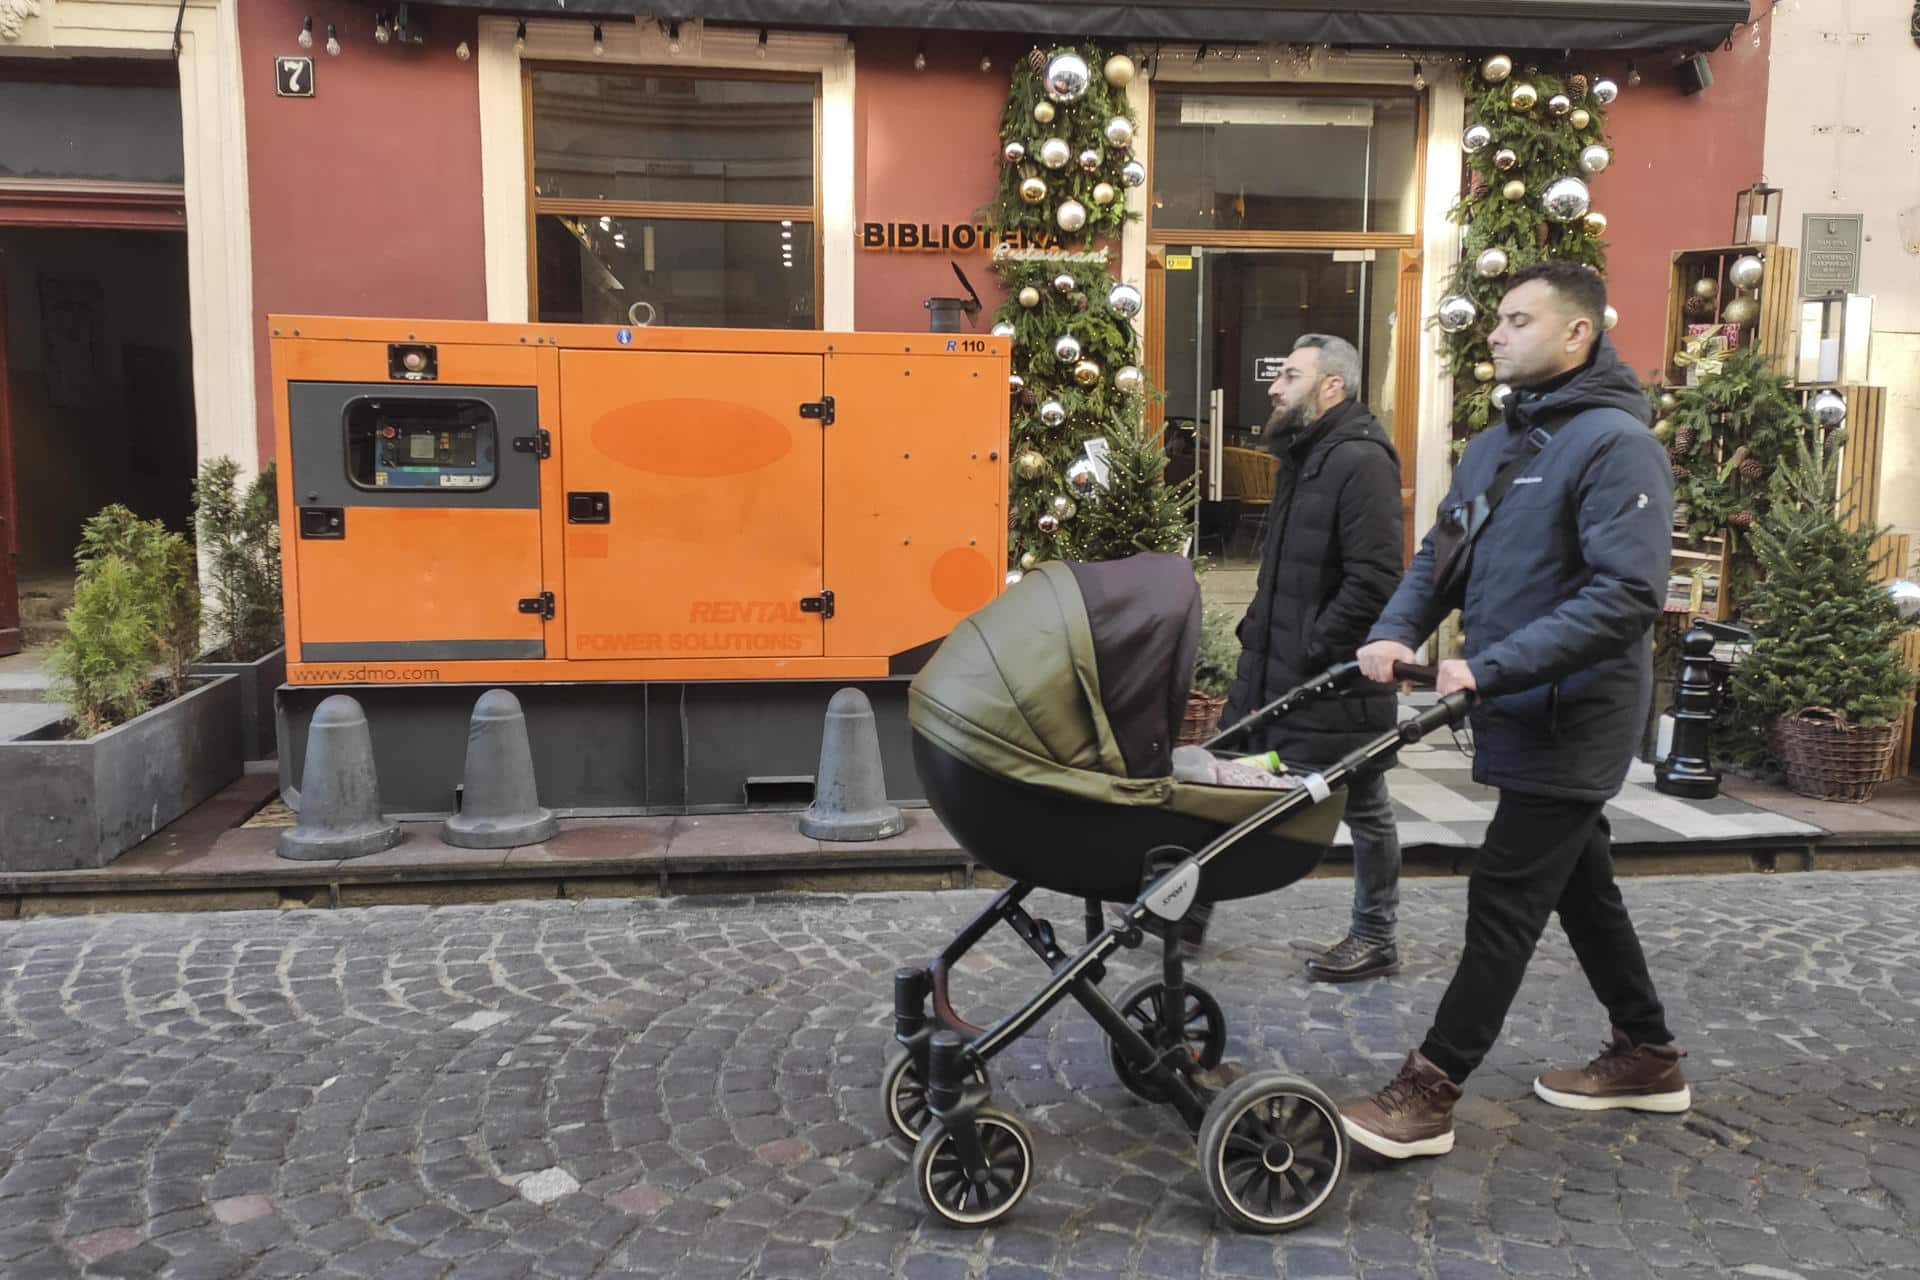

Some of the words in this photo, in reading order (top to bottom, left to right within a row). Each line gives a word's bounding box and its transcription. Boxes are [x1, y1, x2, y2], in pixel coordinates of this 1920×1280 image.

[283, 61, 304, 92] 7
[946, 340, 957, 351] R
[961, 340, 985, 352] 110
[689, 601, 807, 624] RENTAL
[576, 633, 663, 651] POWER
[668, 632, 803, 650] SOLUTIONS
[294, 666, 440, 681] www.sdmo.com
